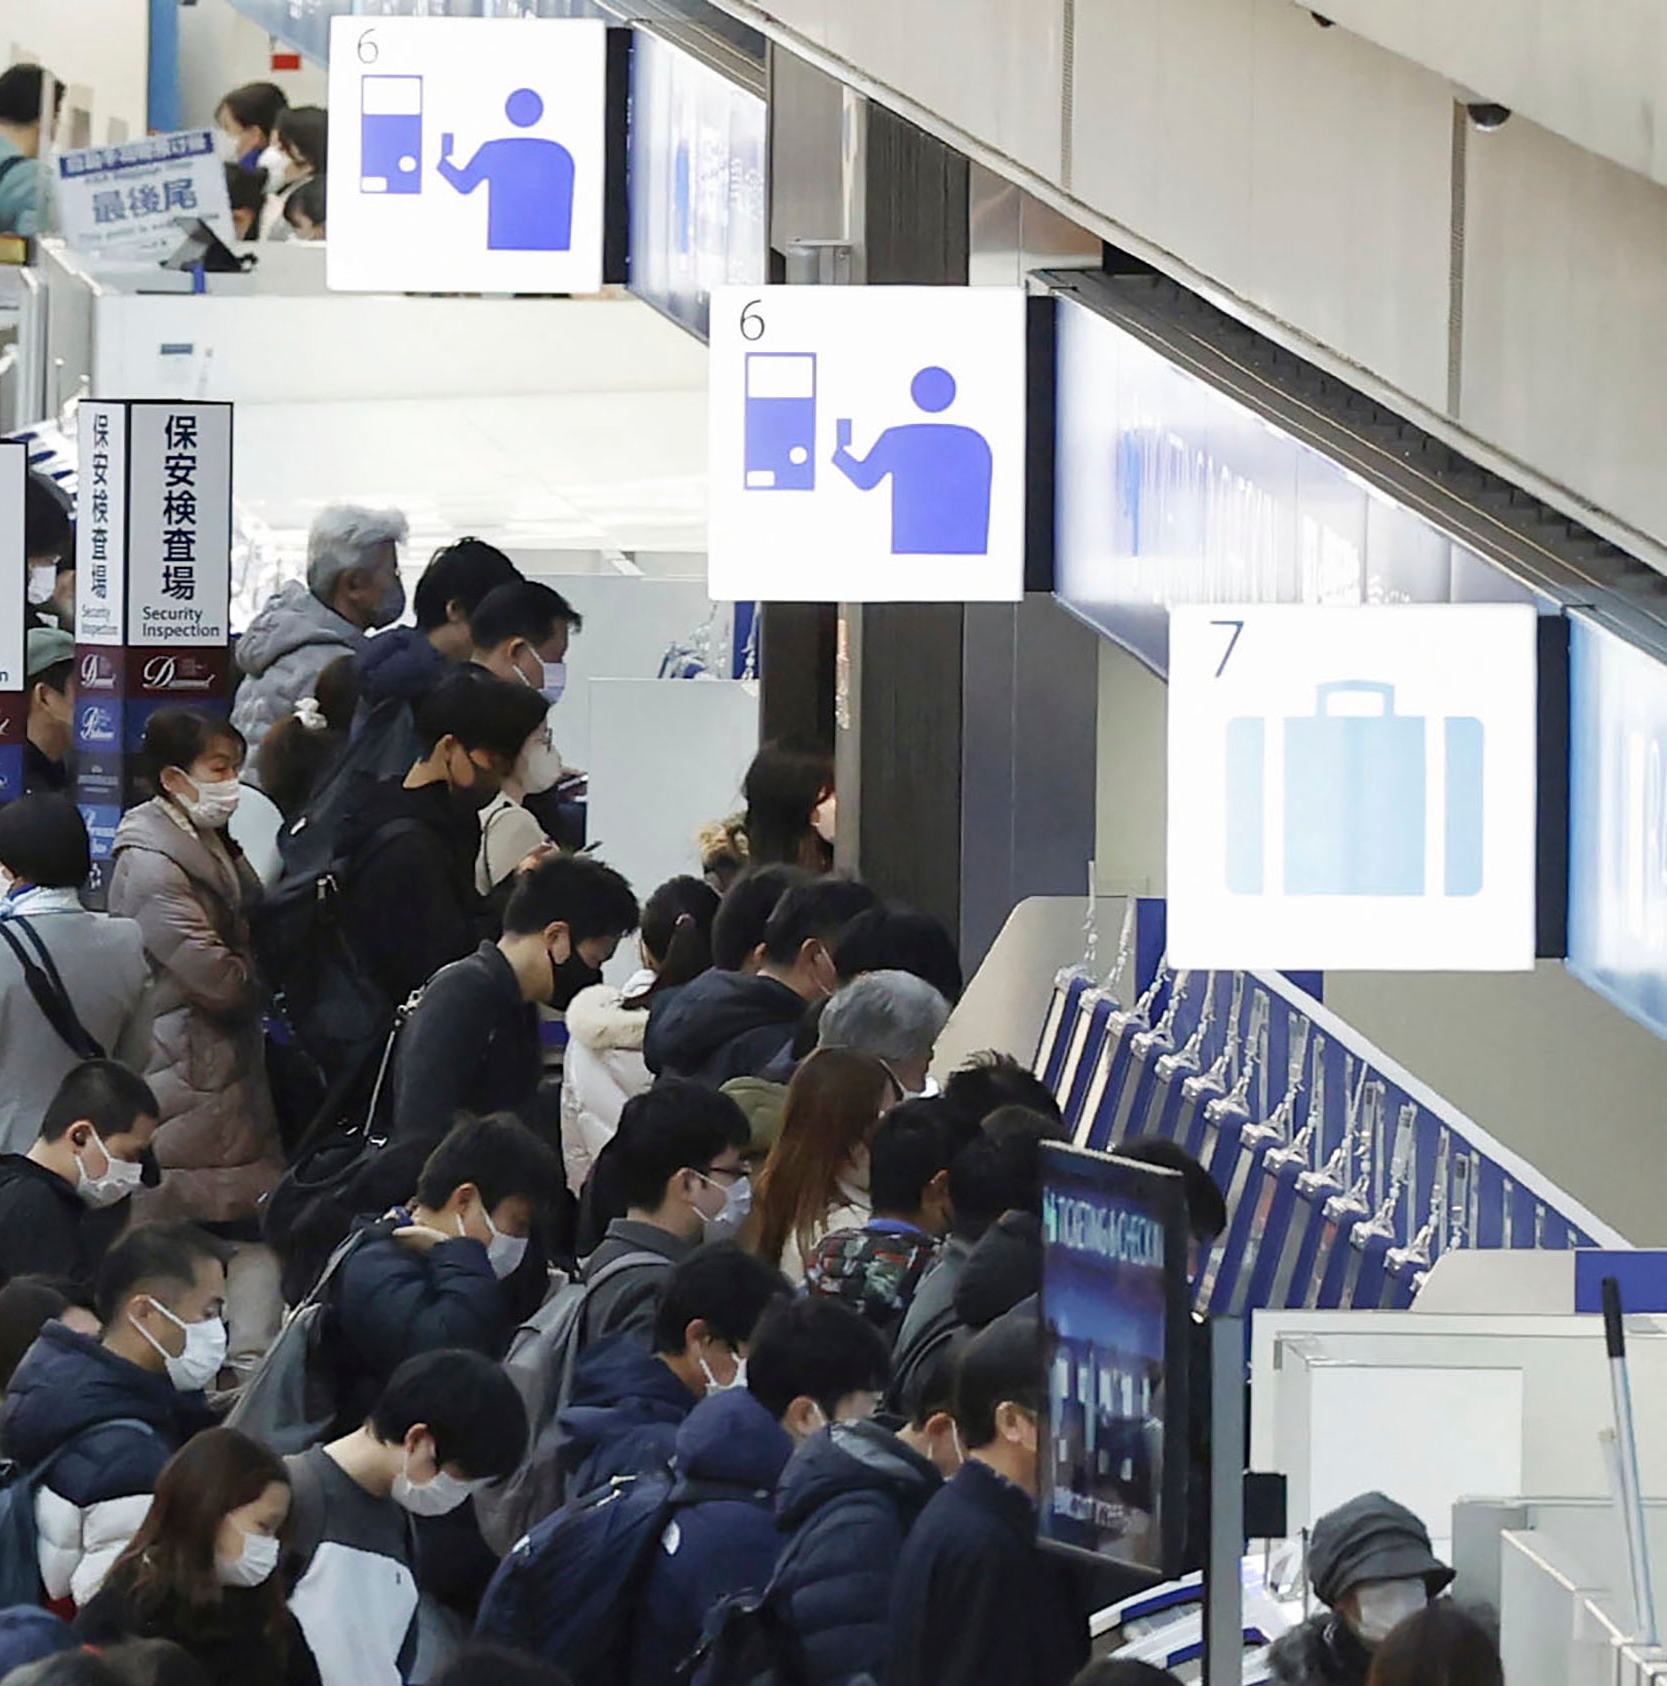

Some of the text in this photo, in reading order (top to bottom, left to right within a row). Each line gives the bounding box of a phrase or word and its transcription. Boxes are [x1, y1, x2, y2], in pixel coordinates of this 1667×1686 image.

[357, 28, 379, 64] 6
[93, 178, 198, 223] 最後尾
[740, 299, 765, 341] 6
[162, 415, 198, 600] 保安検査場
[142, 606, 203, 624] Security
[142, 623, 220, 641] Inspection
[1210, 620, 1244, 678] 7
